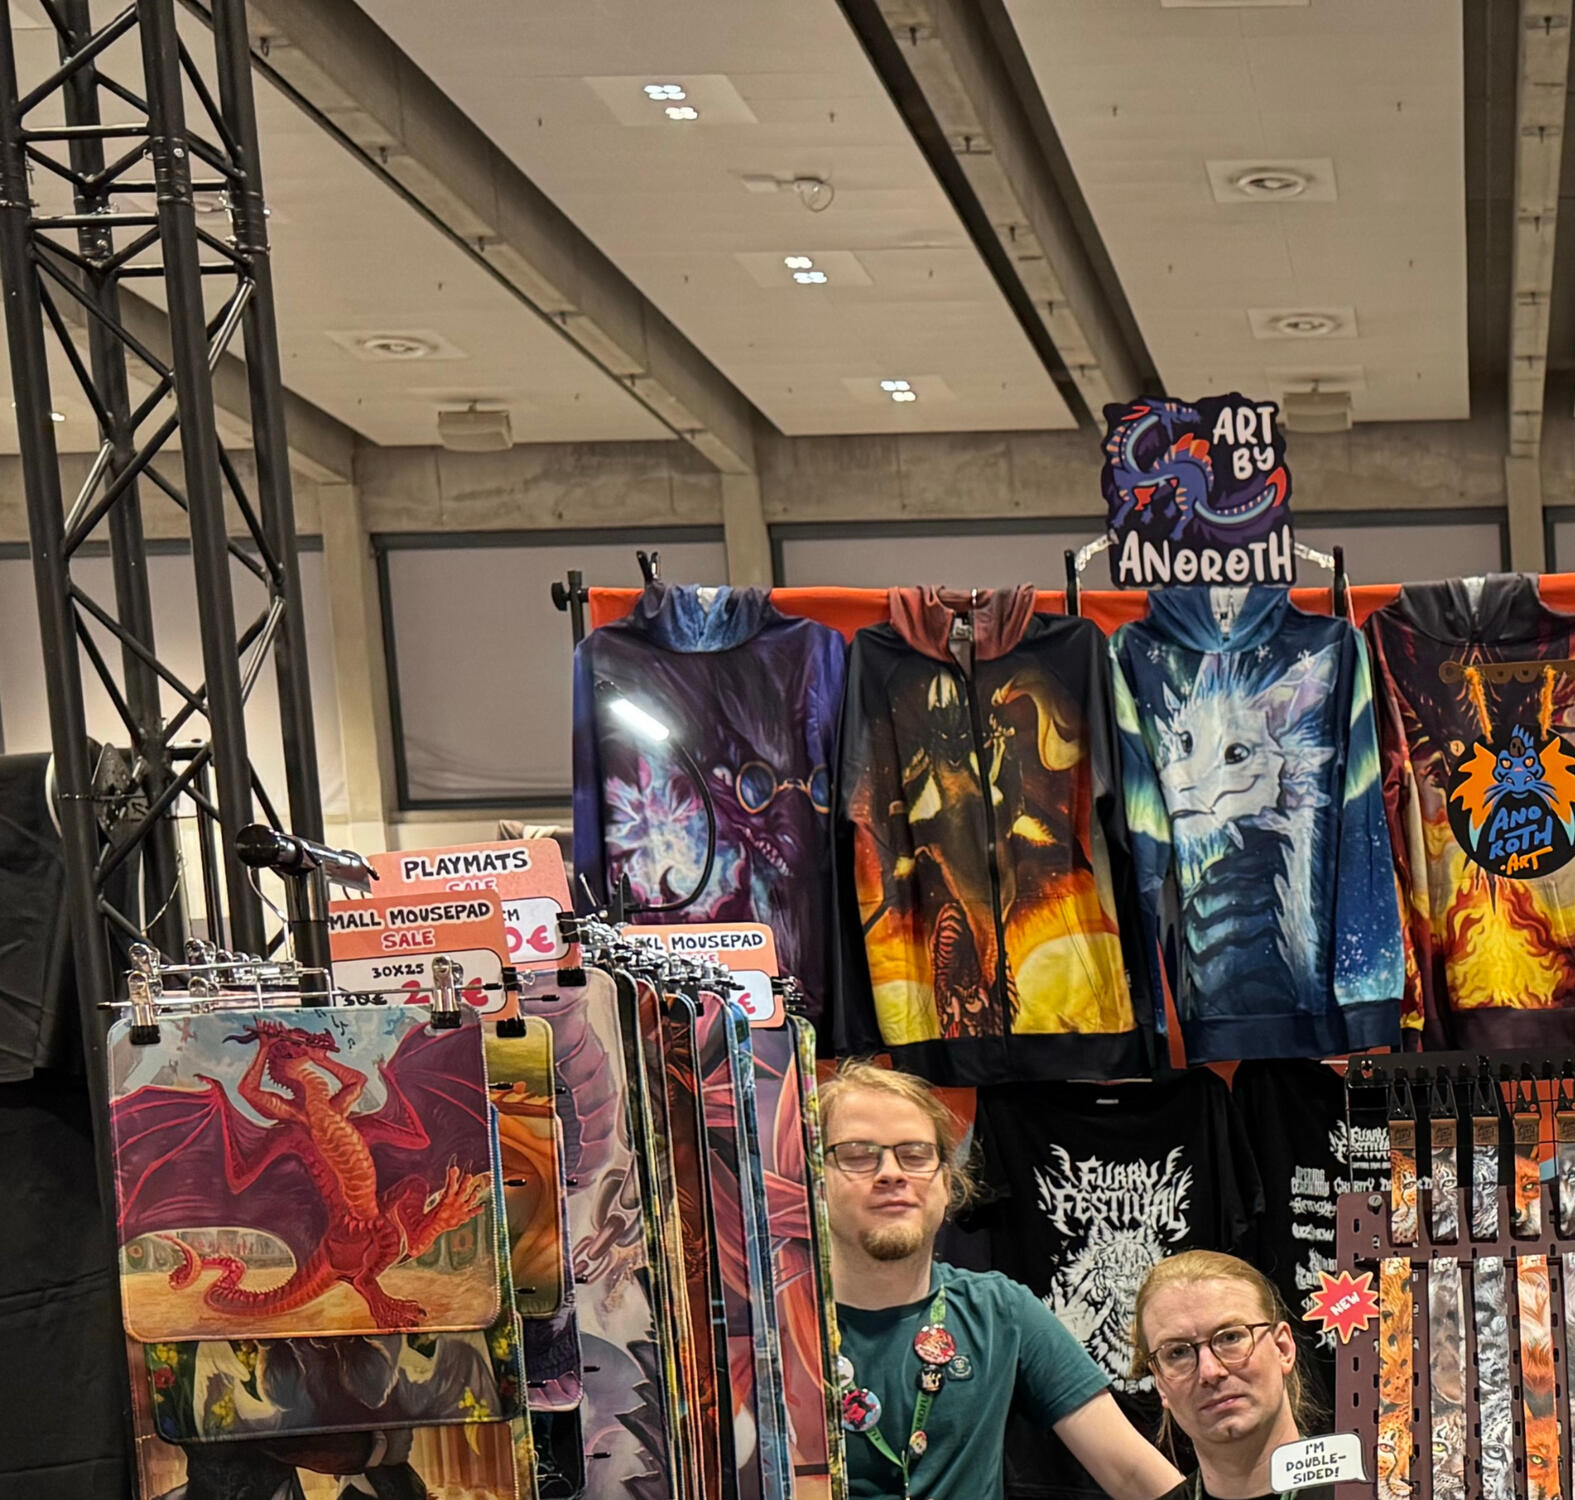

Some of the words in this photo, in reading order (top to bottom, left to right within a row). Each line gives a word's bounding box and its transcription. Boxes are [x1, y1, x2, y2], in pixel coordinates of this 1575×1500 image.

[1213, 406, 1275, 445] ART
[1232, 446, 1276, 480] BY
[1119, 525, 1294, 583] ANOROTH
[1489, 806, 1542, 842] ANO
[1489, 816, 1553, 861] ROTH
[404, 850, 529, 880] PLAYMATS
[1500, 846, 1553, 876] .ART
[390, 903, 491, 926] MOUSEPAD
[384, 931, 434, 949] SALE
[672, 933, 763, 950] MOUSEPAD
[371, 964, 425, 979] 30X25
[1076, 1154, 1161, 1193] FURRY
[1330, 1291, 1360, 1317] NEW
[1305, 1441, 1325, 1456] I'M
[1285, 1455, 1347, 1473] DOUBLE-
[1292, 1467, 1340, 1485] SIDED!
